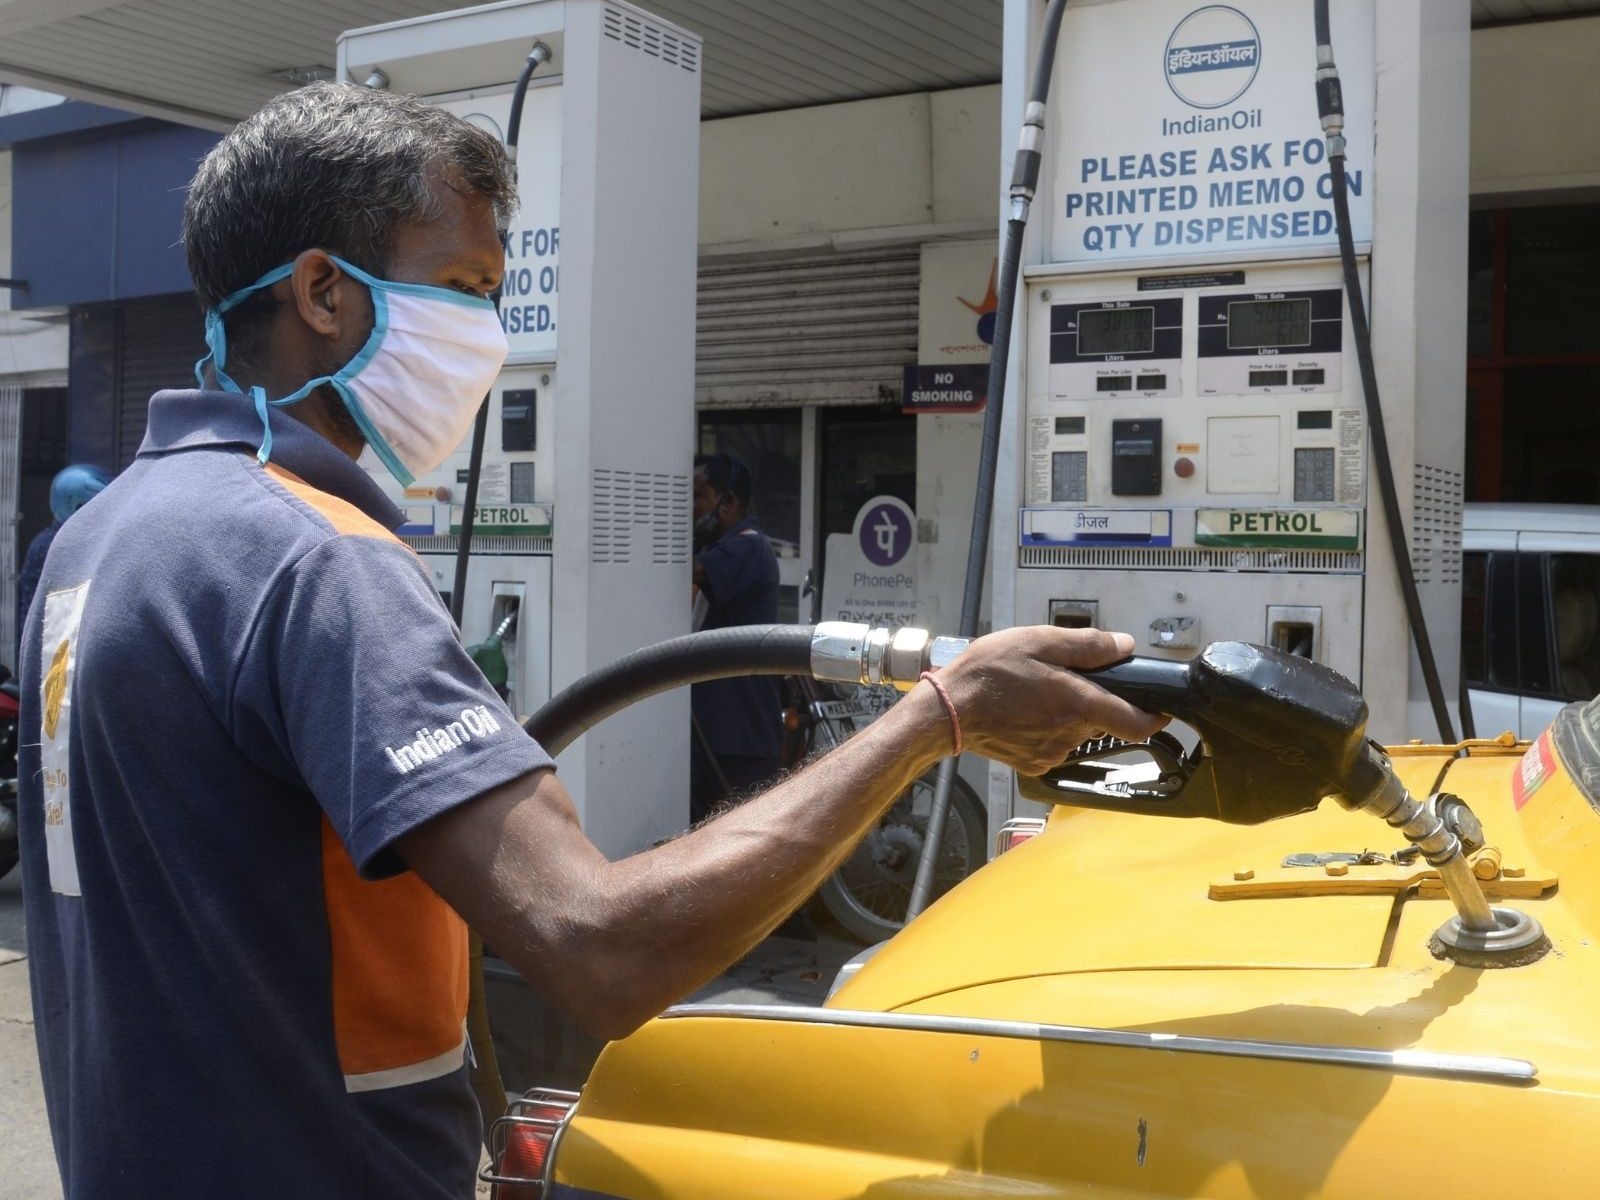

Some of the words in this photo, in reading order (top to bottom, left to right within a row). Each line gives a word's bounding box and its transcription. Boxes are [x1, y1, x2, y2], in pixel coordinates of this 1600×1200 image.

[1169, 44, 1256, 73] इंडियनऑयल
[1162, 109, 1262, 137] IndianOil
[1081, 150, 1197, 184] PLEASE
[1208, 143, 1272, 174] ASK
[1284, 137, 1347, 167] FO
[1066, 184, 1198, 218] PRINTED
[1209, 176, 1304, 208] MEMO
[1083, 223, 1144, 252] QTY
[501, 266, 532, 297] MO
[540, 265, 560, 295] O
[499, 304, 556, 335] NSED.
[935, 373, 953, 384] NO
[912, 390, 973, 402] SMOKING
[472, 508, 529, 523] PETROL
[1229, 512, 1323, 533] PETROL
[854, 572, 913, 589] PhonePe
[385, 704, 501, 774] IndianOil
